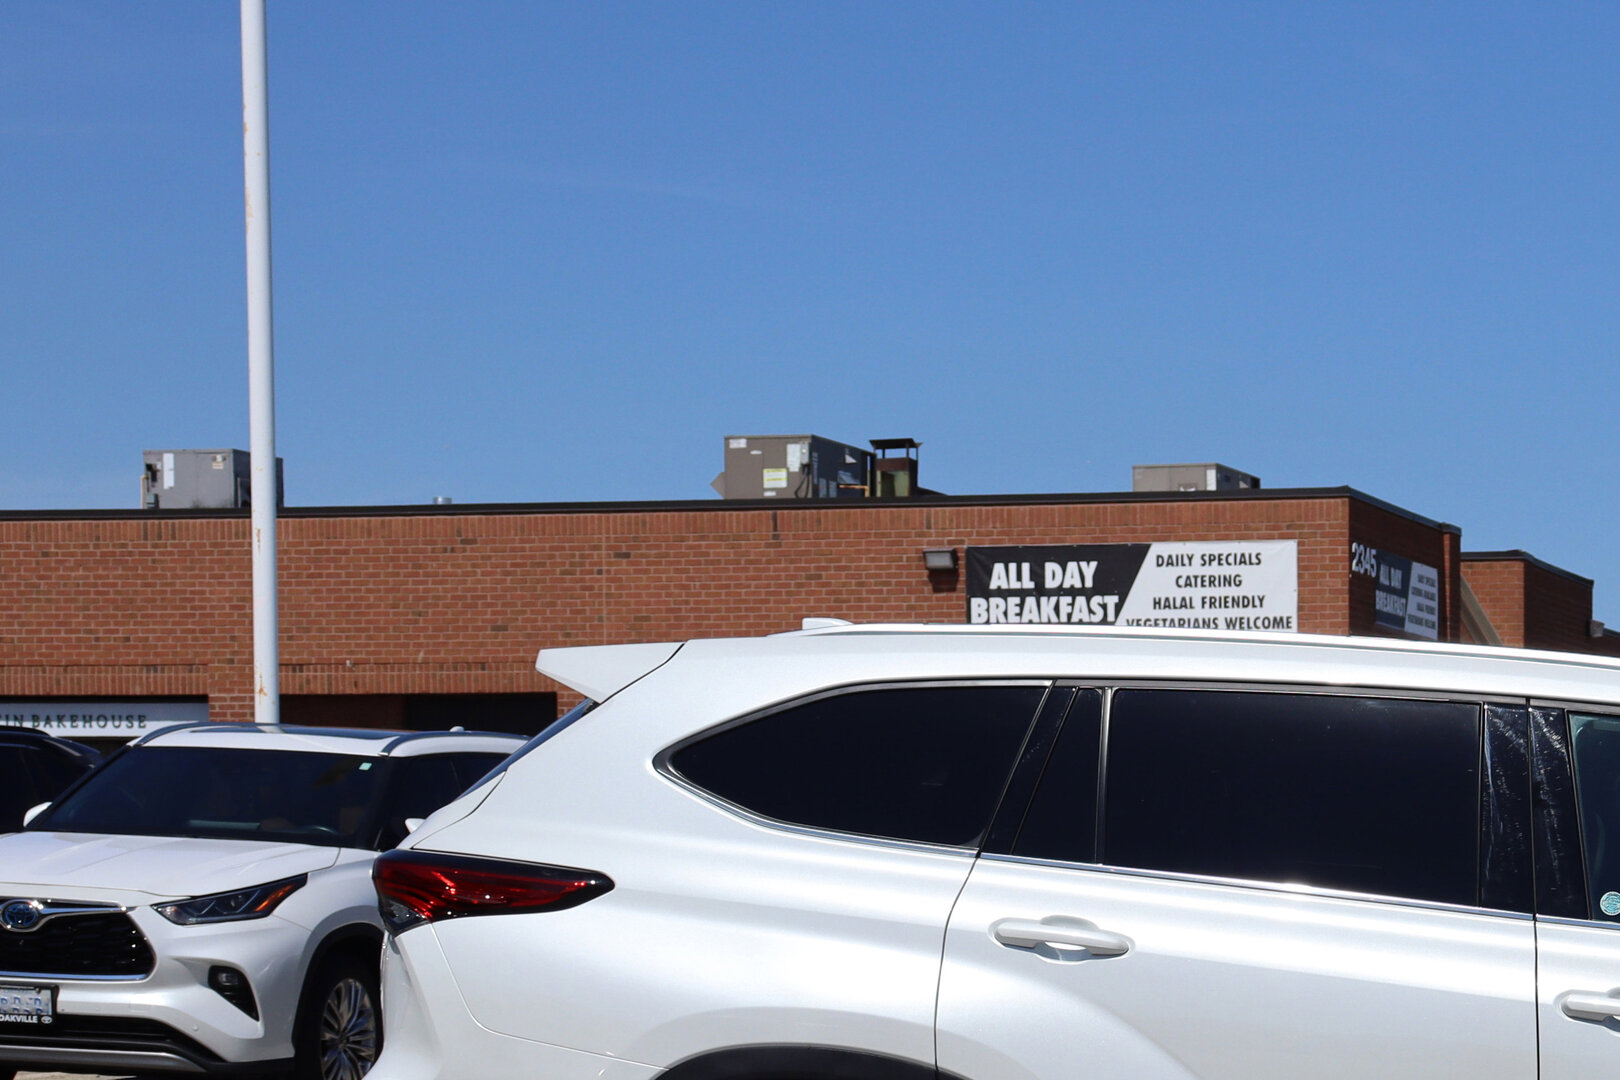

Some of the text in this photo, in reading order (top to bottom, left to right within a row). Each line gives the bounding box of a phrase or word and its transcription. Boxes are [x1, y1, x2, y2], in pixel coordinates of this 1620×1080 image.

[1155, 552, 1262, 568] DAILY SPECIALS
[1351, 542, 1377, 578] 2345
[988, 561, 1098, 589] ALL DAY
[1175, 574, 1243, 588] CATERING
[970, 595, 1119, 624] BREAKFAST
[1153, 595, 1265, 610] HALAL FRIENDLY
[1224, 616, 1292, 630] WELCOME
[31, 714, 147, 728] BAKEHOUSE
